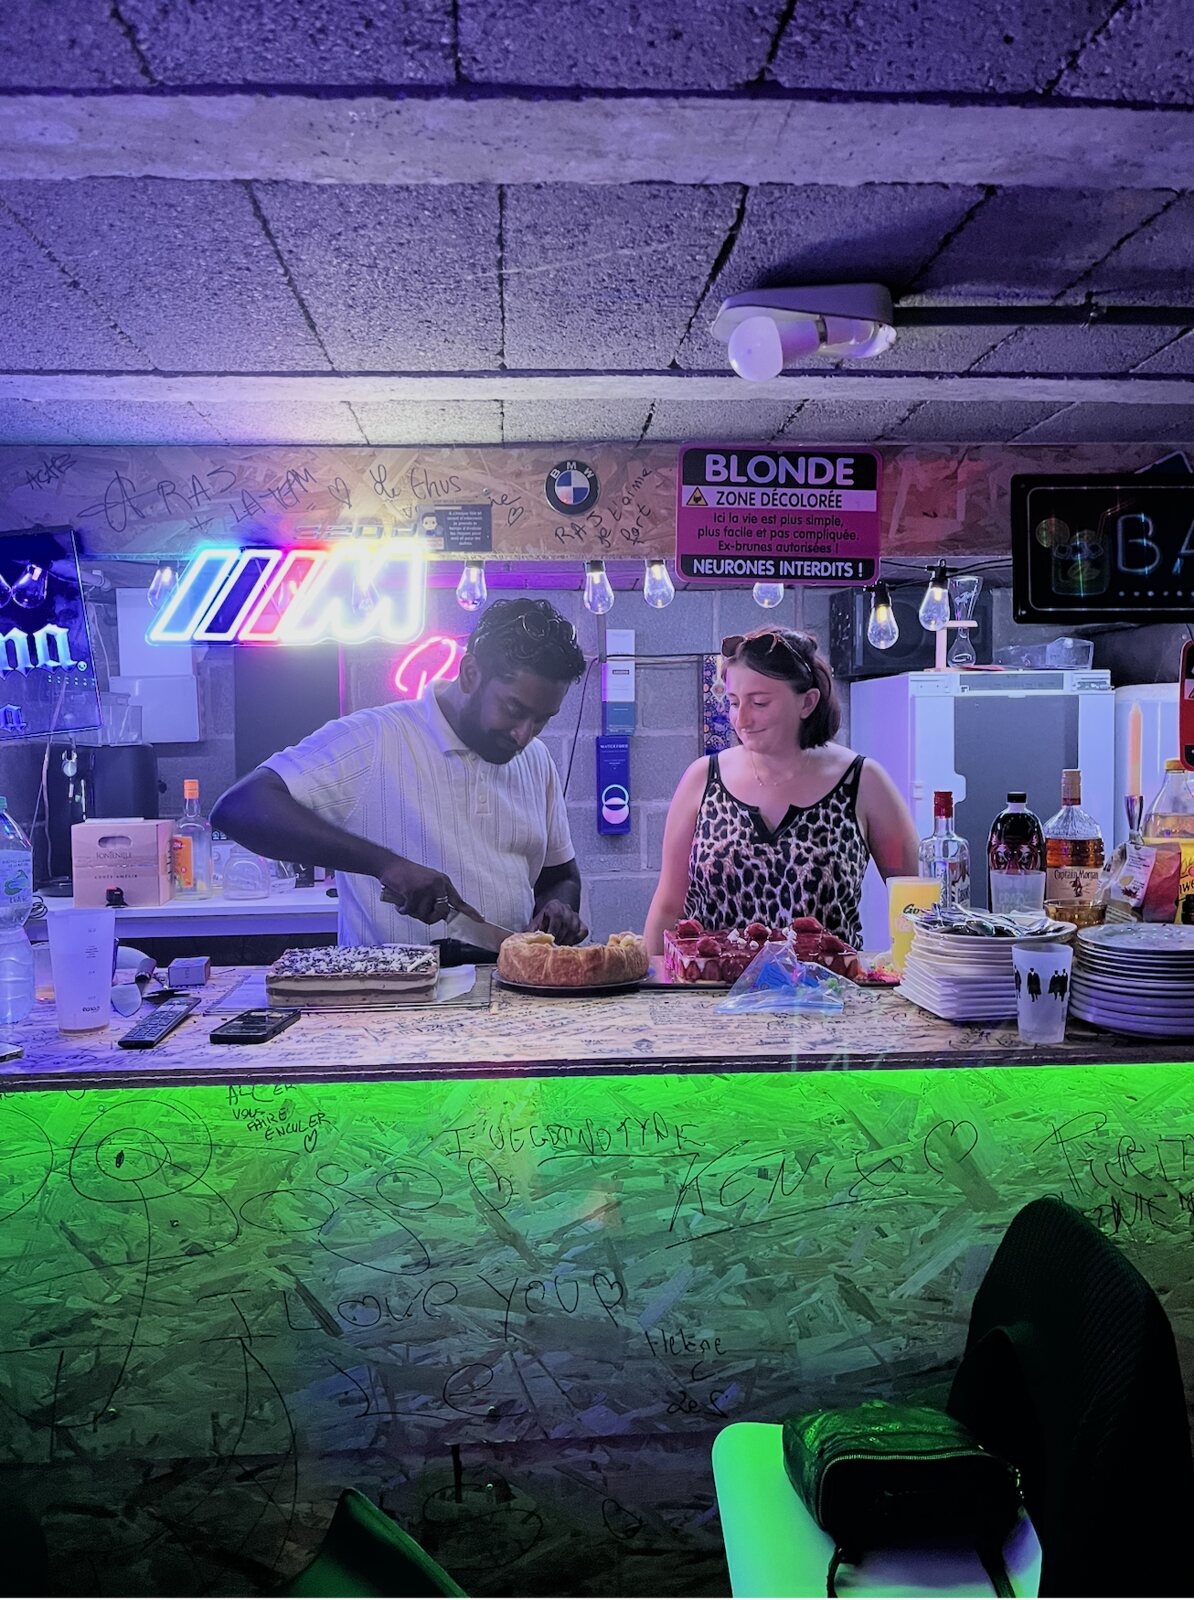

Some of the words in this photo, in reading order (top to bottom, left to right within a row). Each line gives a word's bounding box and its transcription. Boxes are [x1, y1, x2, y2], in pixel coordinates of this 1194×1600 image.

[550, 461, 595, 479] BMW
[705, 453, 855, 487] BLONDE
[716, 490, 756, 507] ZONE
[760, 488, 843, 509] DÉCOLORÉE
[713, 512, 726, 523] Ici
[728, 512, 739, 524] la
[742, 513, 758, 524] vie
[760, 513, 777, 525] est
[780, 513, 803, 527] plus
[805, 514, 844, 528] simple,
[697, 526, 721, 539] plus
[723, 526, 753, 538] facile
[756, 527, 766, 538] et
[769, 529, 790, 541] pas
[793, 528, 860, 542] compliquée.
[718, 540, 773, 552] Ex-brunes
[775, 541, 832, 554] autorisées
[693, 558, 775, 576] NEURONES
[779, 560, 854, 577] INTERDITS
[858, 561, 863, 578] !
